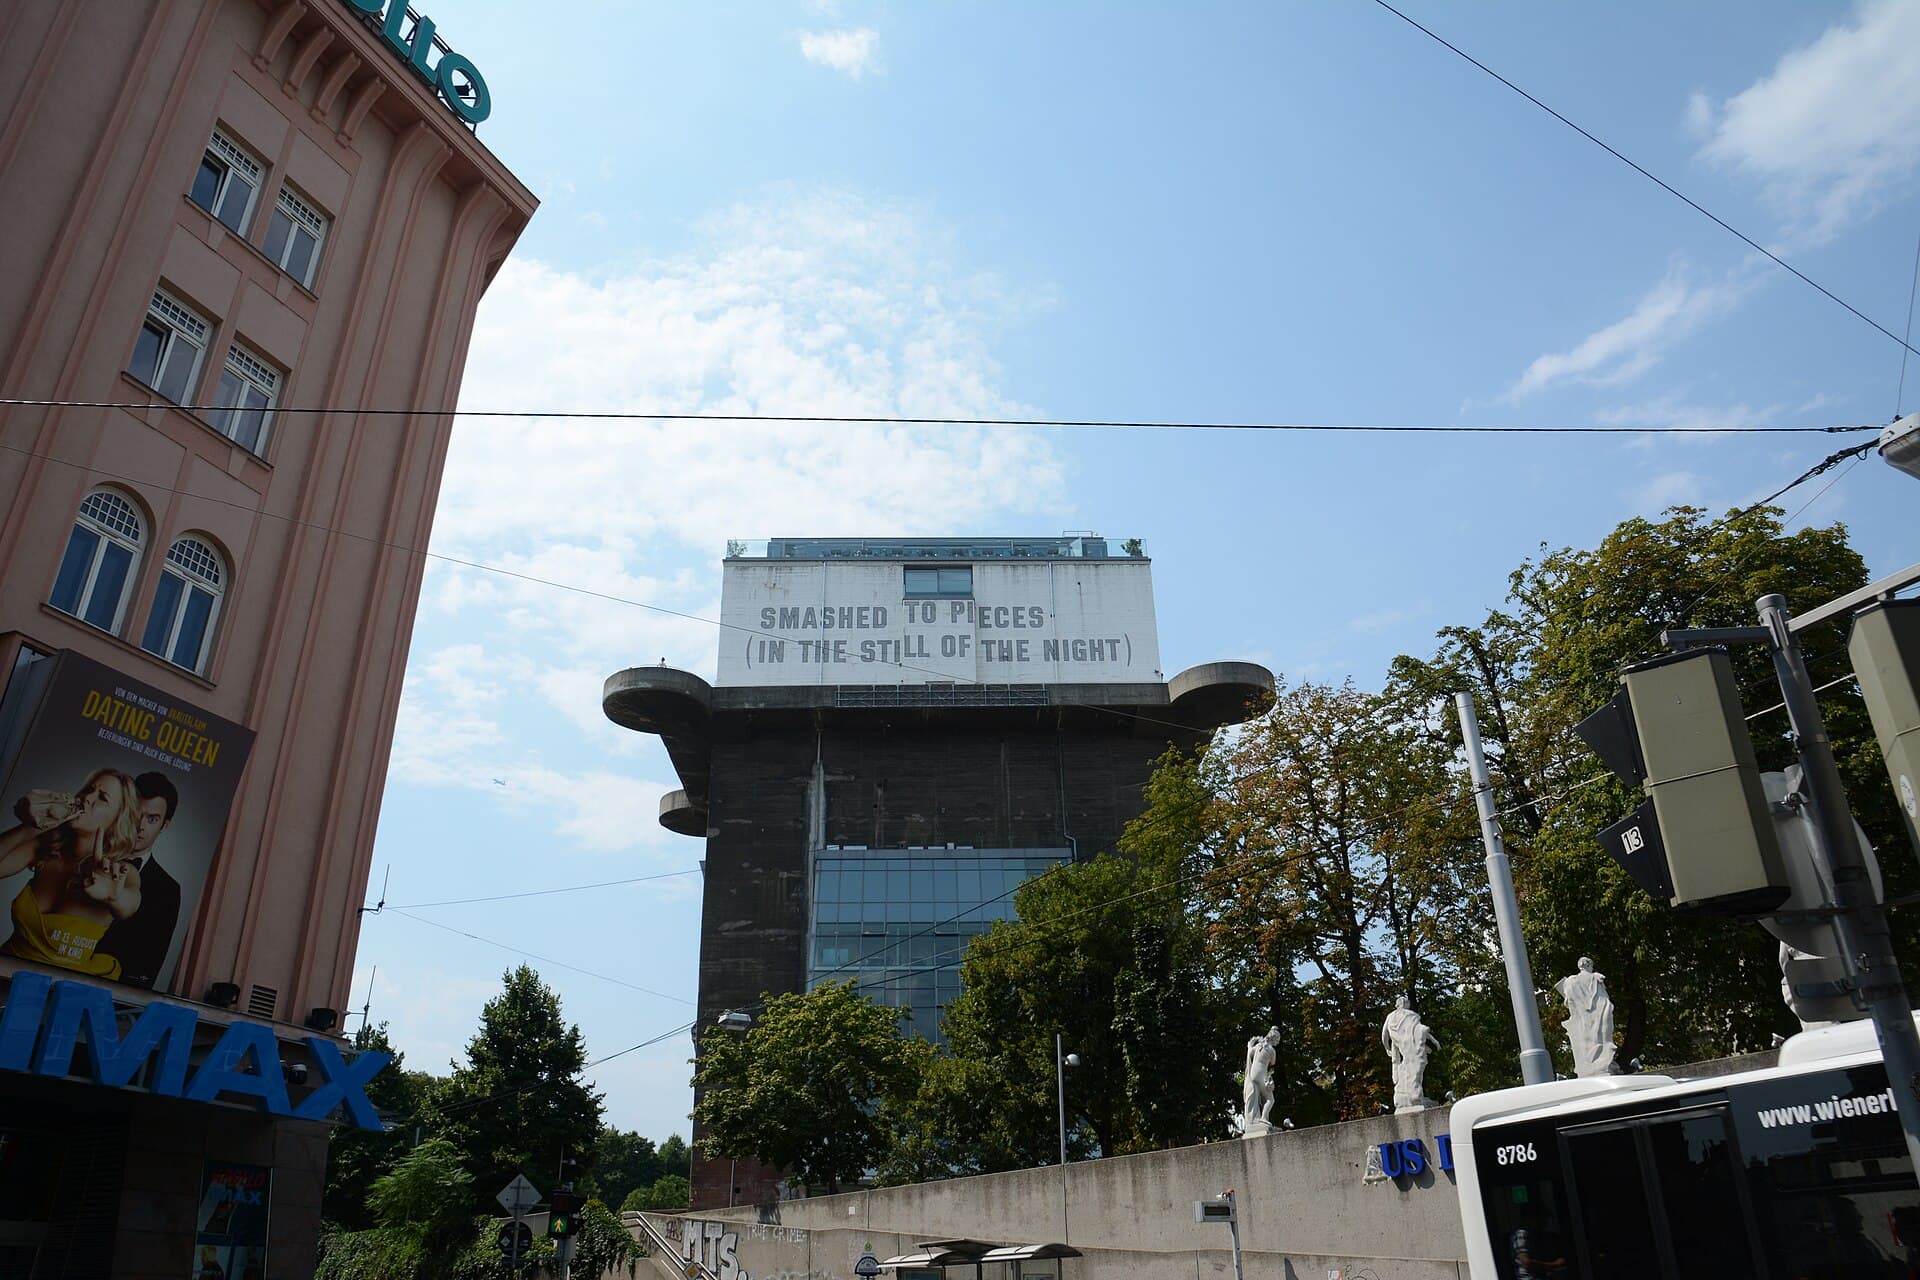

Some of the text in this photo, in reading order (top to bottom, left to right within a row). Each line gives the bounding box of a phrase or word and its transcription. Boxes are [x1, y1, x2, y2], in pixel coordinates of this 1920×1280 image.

[760, 601, 1044, 629] SMASHED TO PIECES
[746, 634, 1131, 670] (IN THE STILL OF THE NIGHT)
[81, 689, 221, 768] DATING QUEEN
[1623, 829, 1642, 851] 13
[0, 970, 393, 1132] IMAX
[1496, 1142, 1538, 1165] 8786
